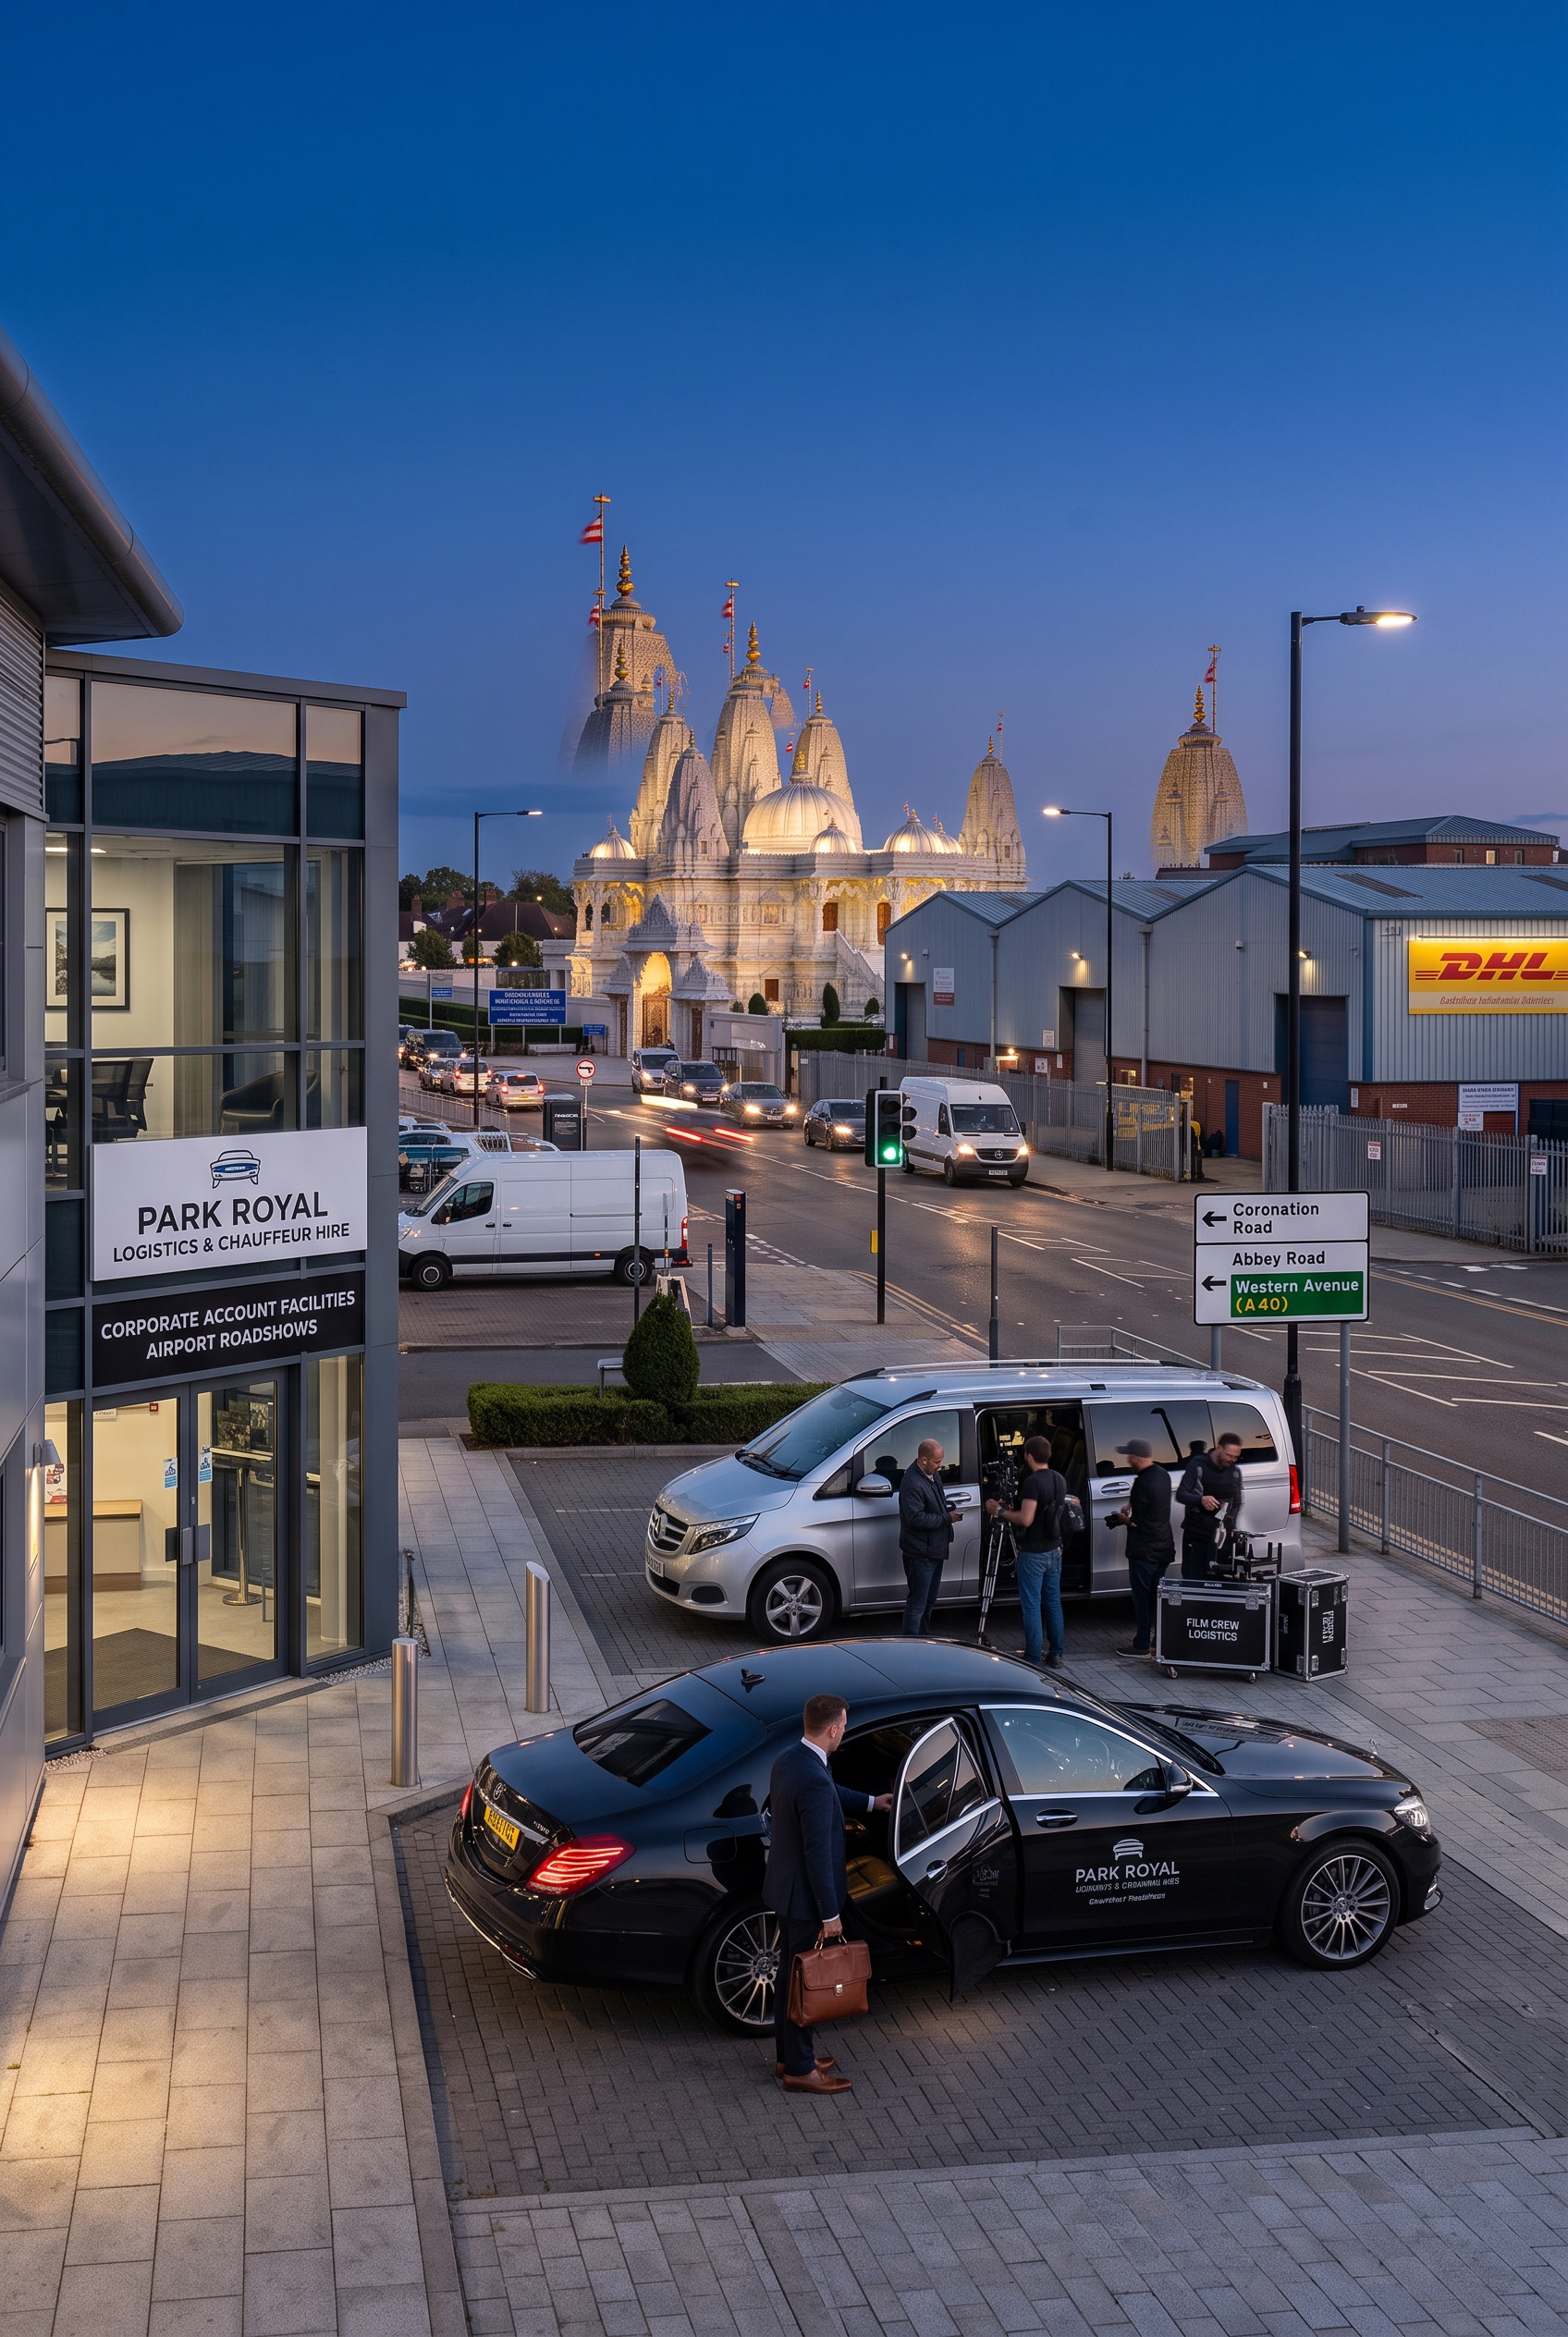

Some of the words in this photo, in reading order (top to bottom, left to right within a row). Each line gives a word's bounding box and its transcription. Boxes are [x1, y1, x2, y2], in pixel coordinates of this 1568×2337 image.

[1438, 952, 1556, 980] DHL
[138, 1200, 222, 1235] PARK
[233, 1192, 328, 1226] ROYAL
[1232, 1202, 1319, 1217] Coronation
[1233, 1220, 1272, 1234] Road
[114, 1239, 198, 1262] LOGISTICS
[202, 1237, 214, 1253] &
[218, 1227, 312, 1251] CHAUFFEUR
[316, 1223, 349, 1240] HIRE
[1232, 1252, 1281, 1267] Abbey
[1287, 1250, 1325, 1265] Road
[1236, 1280, 1298, 1293] Western
[1304, 1279, 1359, 1292] Avenue
[1235, 1296, 1288, 1314] (A40)
[101, 1311, 200, 1340] CORPORATE
[202, 1301, 276, 1326] ACCOUNT
[280, 1290, 356, 1315] FACILITIES
[145, 1334, 216, 1360] AIRPORT
[220, 1319, 318, 1348] ROADSHOWS
[1186, 1618, 1209, 1628] FILM
[1210, 1620, 1240, 1631] CREW
[1188, 1630, 1238, 1642] LOGISTICS
[1075, 1866, 1120, 1883] PARK
[1125, 1861, 1180, 1878] ROYAL
